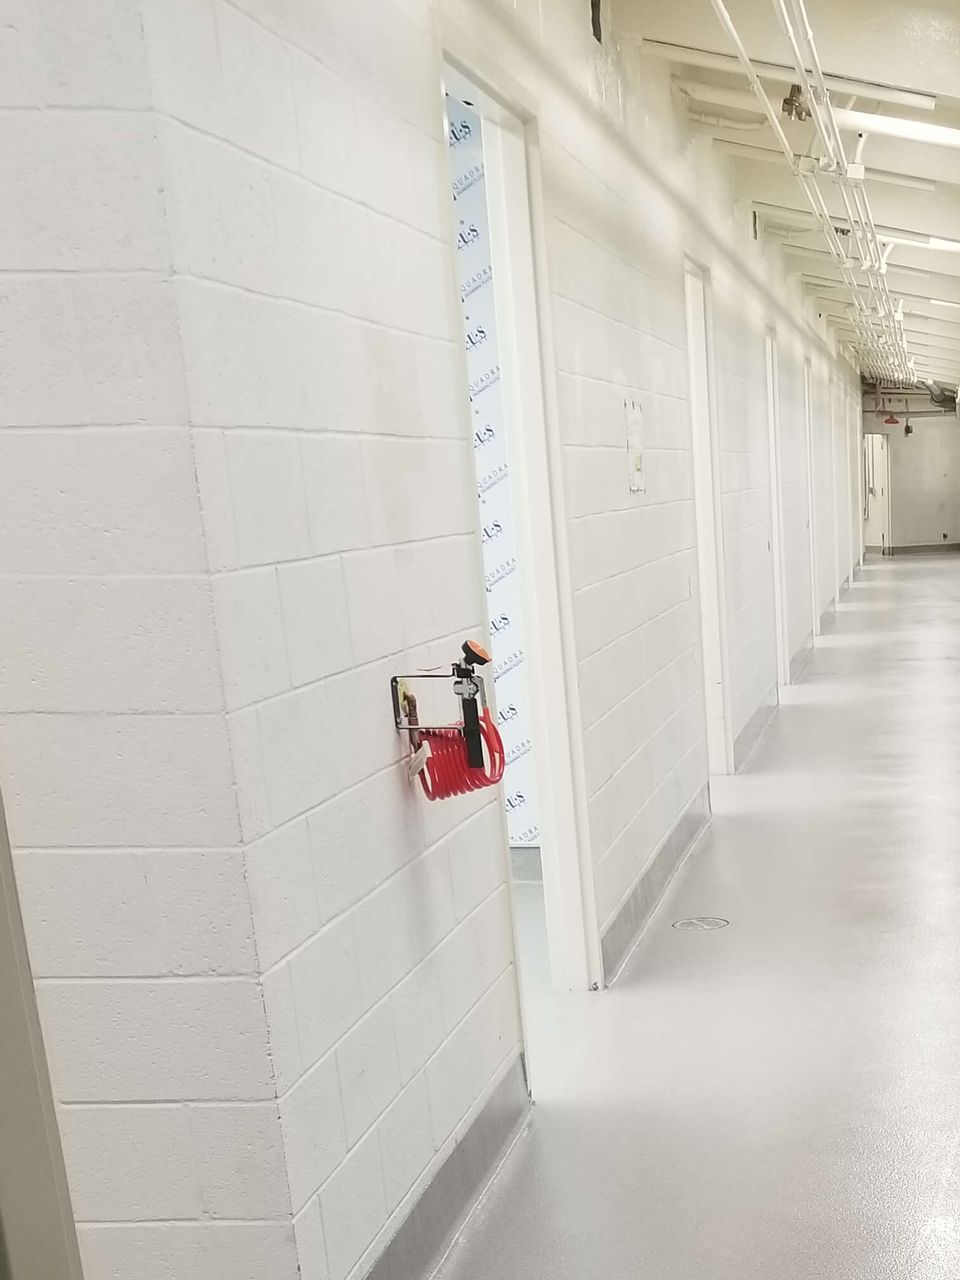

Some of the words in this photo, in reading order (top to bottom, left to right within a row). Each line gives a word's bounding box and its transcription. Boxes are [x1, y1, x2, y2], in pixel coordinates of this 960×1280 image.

[468, 365, 501, 392] QUADRA
[476, 463, 508, 489] QUADRA
[484, 558, 516, 583] QUADRA
[493, 649, 524, 674] QUADRA
